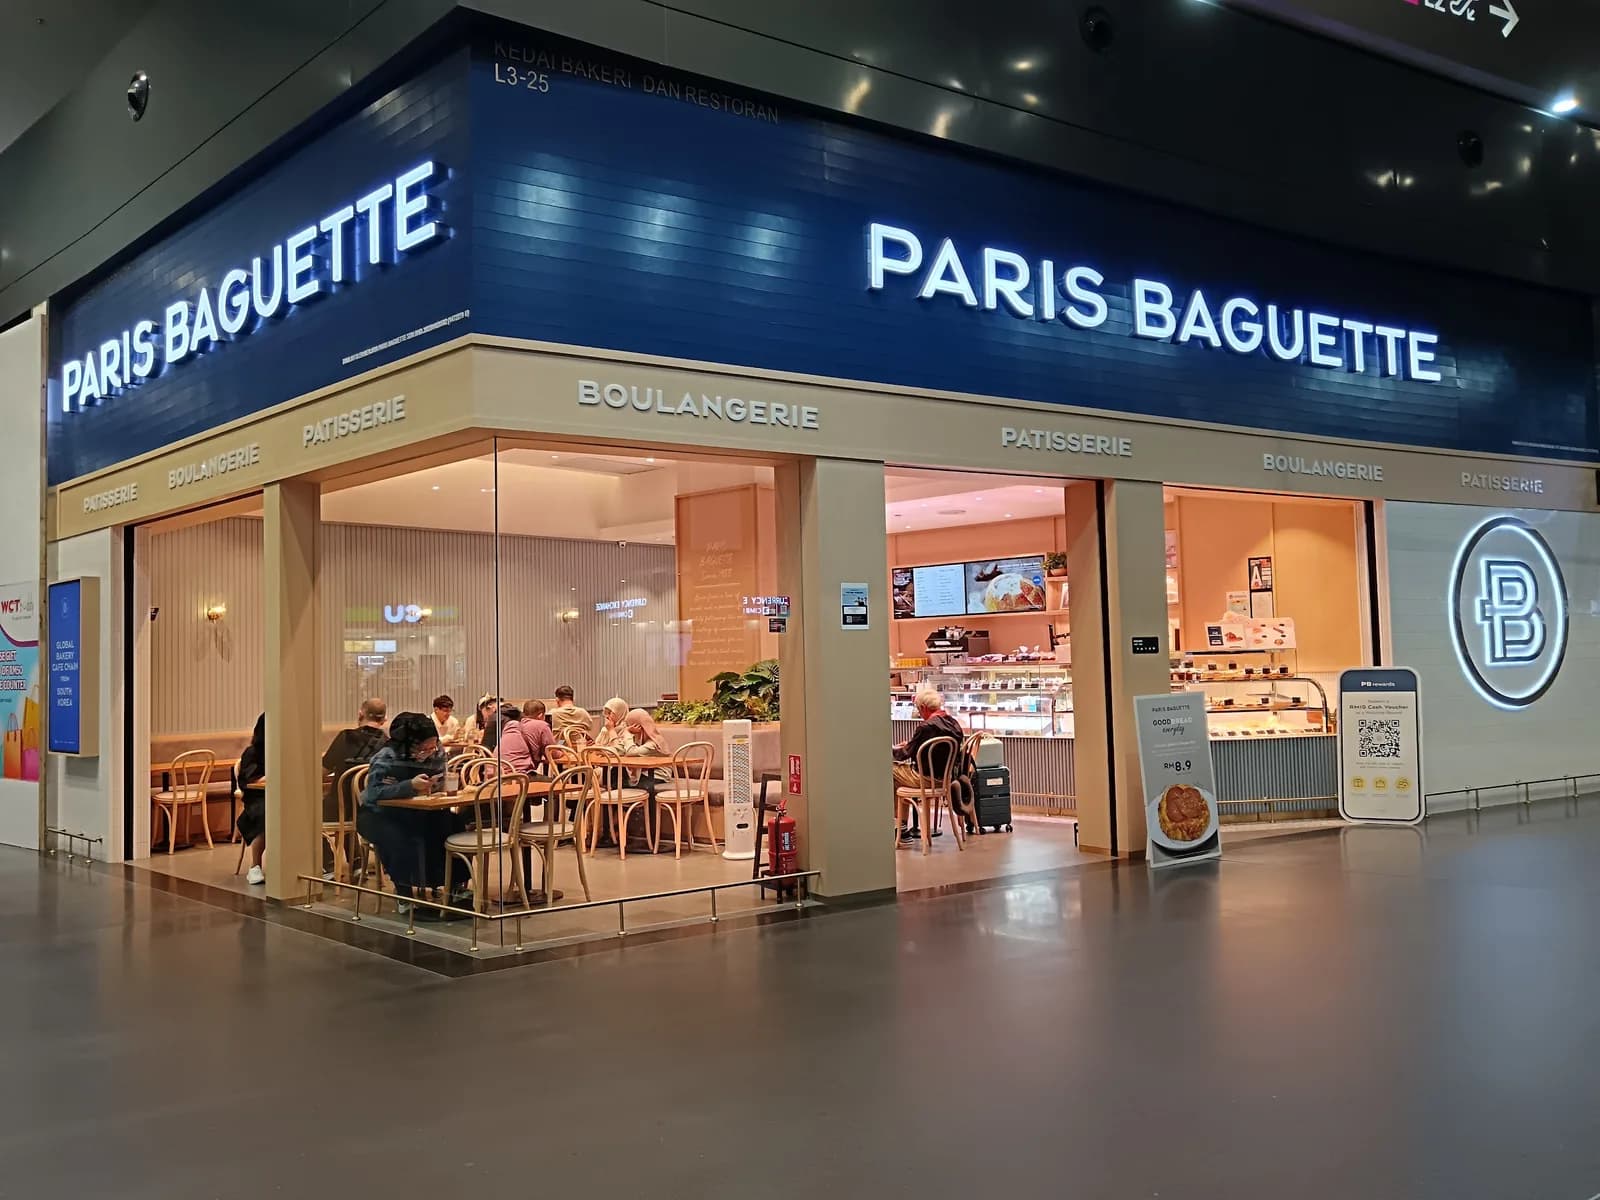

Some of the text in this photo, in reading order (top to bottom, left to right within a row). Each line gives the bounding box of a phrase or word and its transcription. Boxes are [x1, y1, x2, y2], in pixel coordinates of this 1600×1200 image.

[494, 62, 550, 93] L3-25
[494, 40, 779, 124] KEDAI BAKERI DAN RESTORAN
[62, 160, 437, 413] PARIS BAGUETTE
[869, 222, 1442, 382] PARIS BAGUETTE
[578, 380, 819, 429] BOULANGERIE
[303, 395, 406, 447] PATISSERIE
[1001, 427, 1132, 457] PATISSERIE
[168, 443, 260, 489] BOULANGERIE
[1263, 453, 1384, 482] BOULANGERIE
[83, 482, 138, 514] PATISSERIE
[1461, 472, 1544, 494] PATISSERIE
[1, 599, 20, 613] WCT
[55, 651, 75, 661] BAKERY
[56, 640, 75, 650] GLOBAL
[65, 662, 79, 671] CHAIN
[56, 687, 73, 696] SOUTH
[57, 697, 73, 707] KOREA
